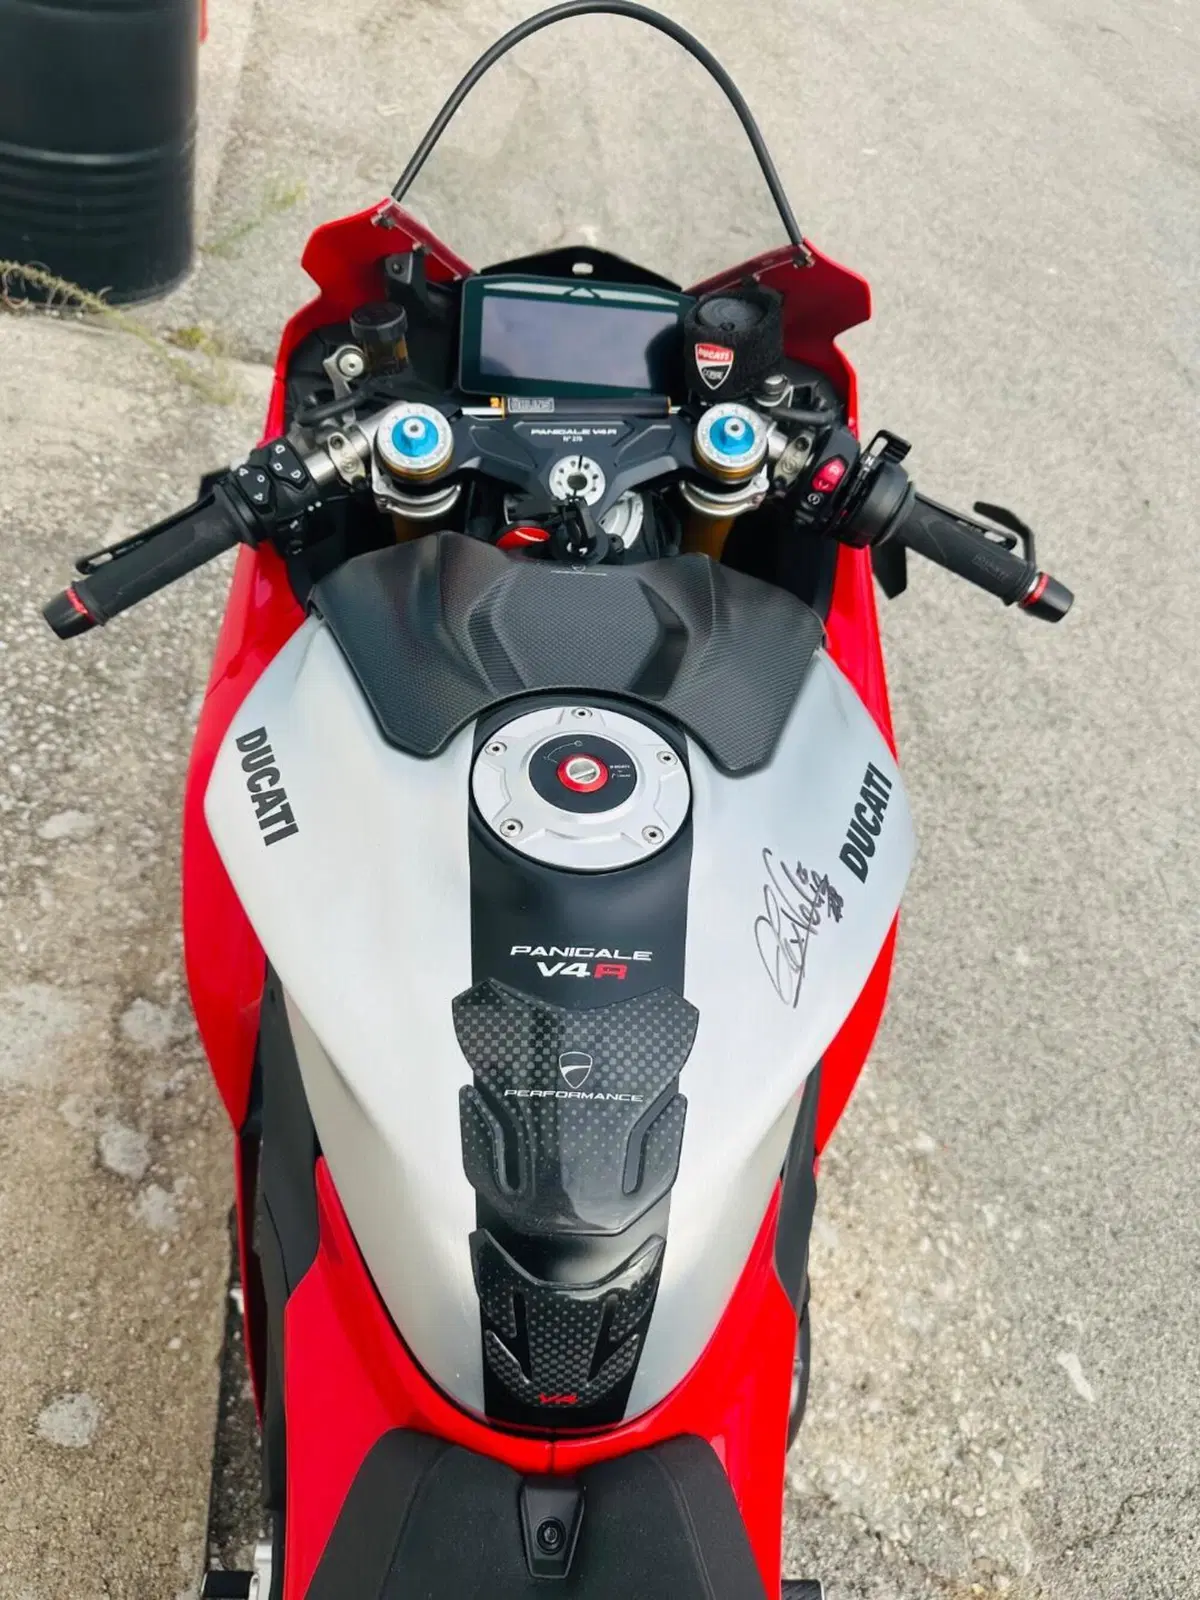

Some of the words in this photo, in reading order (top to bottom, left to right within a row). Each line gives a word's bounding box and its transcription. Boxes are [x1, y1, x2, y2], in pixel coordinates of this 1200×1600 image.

[531, 428, 591, 436] PANIGALE
[235, 726, 299, 847] DUCATI
[839, 761, 893, 884] DUCATI
[510, 945, 653, 961] PANIGALE
[504, 1089, 644, 1103] PERFORMANCE
